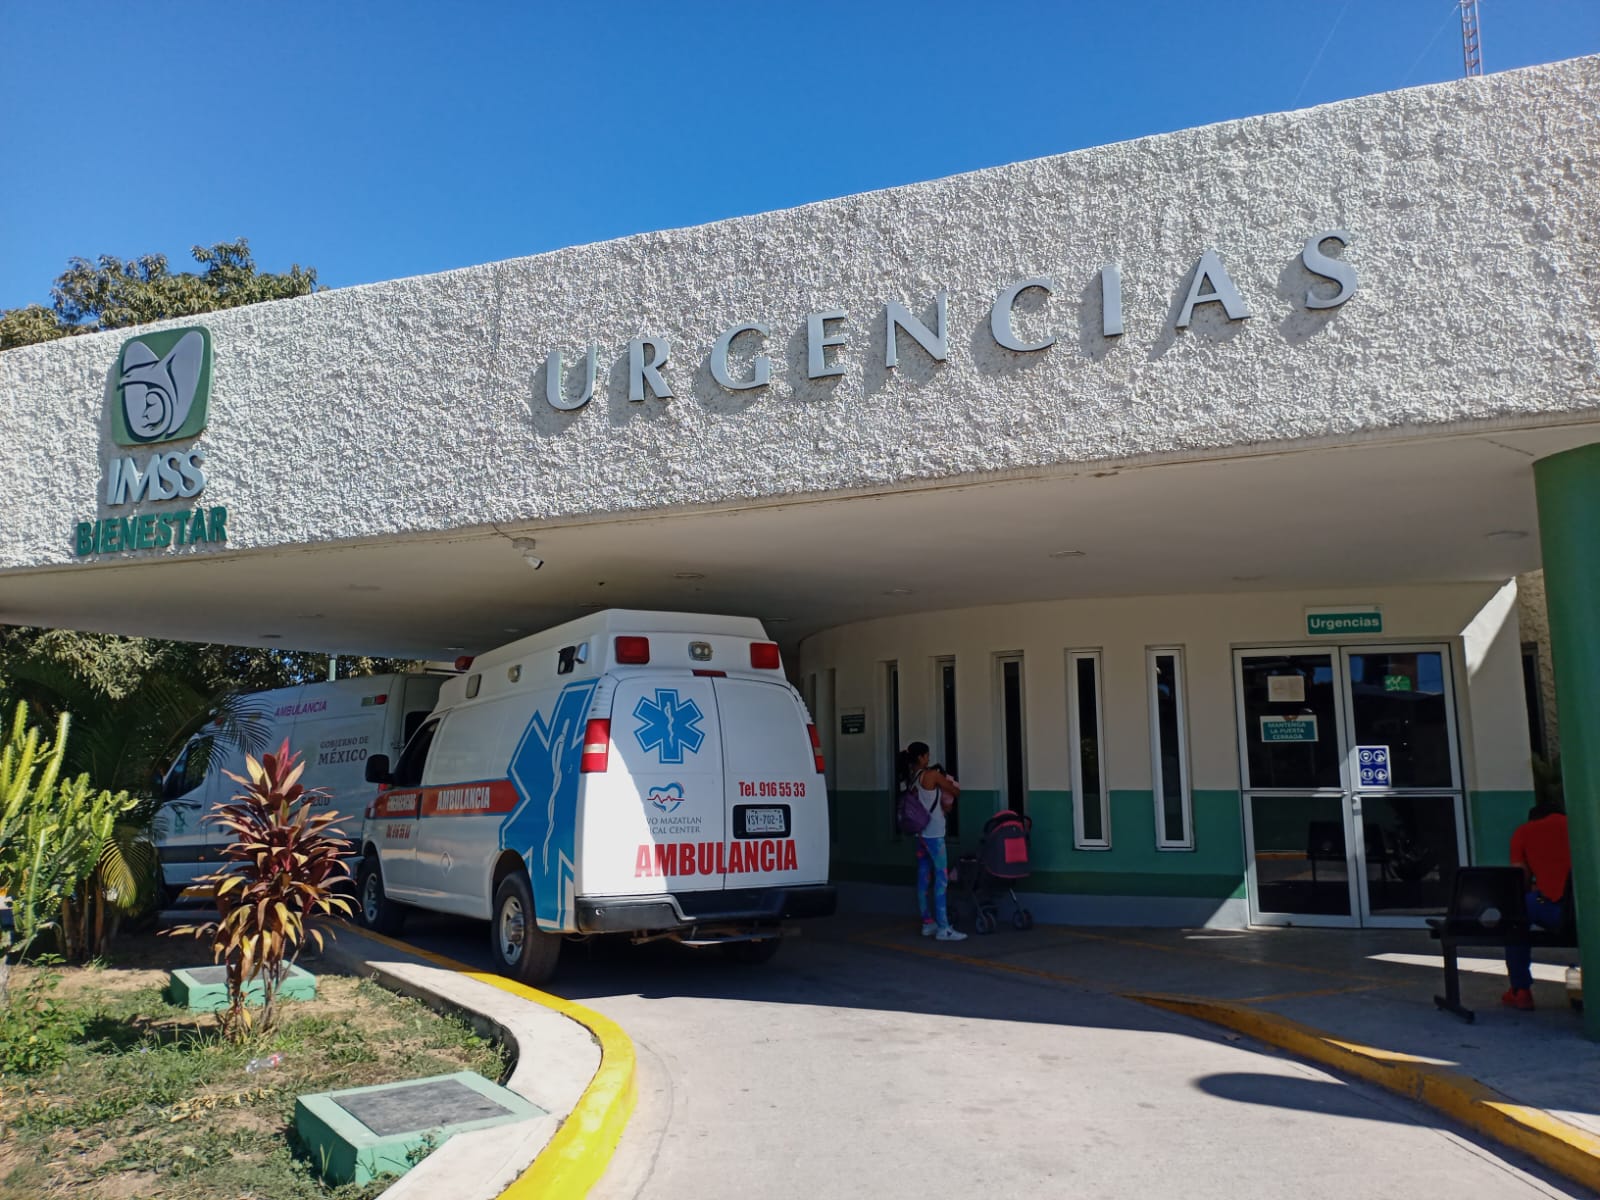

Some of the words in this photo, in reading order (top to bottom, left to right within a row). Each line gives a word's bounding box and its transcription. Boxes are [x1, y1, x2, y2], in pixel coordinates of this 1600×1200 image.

[546, 229, 1359, 412] URGENCIAS
[107, 451, 207, 505] IMSS
[76, 506, 227, 556] BIENESTAR
[1310, 617, 1379, 629] Urgencias
[274, 700, 327, 717] AMBULANCIA
[320, 737, 357, 748] GOBIERNO
[359, 736, 369, 744] DE
[318, 748, 368, 765] MÉXICO
[437, 787, 490, 809] AMBULANCIA
[738, 781, 758, 797] Tel.
[759, 781, 777, 797] 916
[779, 782, 792, 797] 55
[793, 782, 806, 798] 33
[669, 826, 701, 834] CENTER
[634, 839, 798, 878] AMBULANCIA
